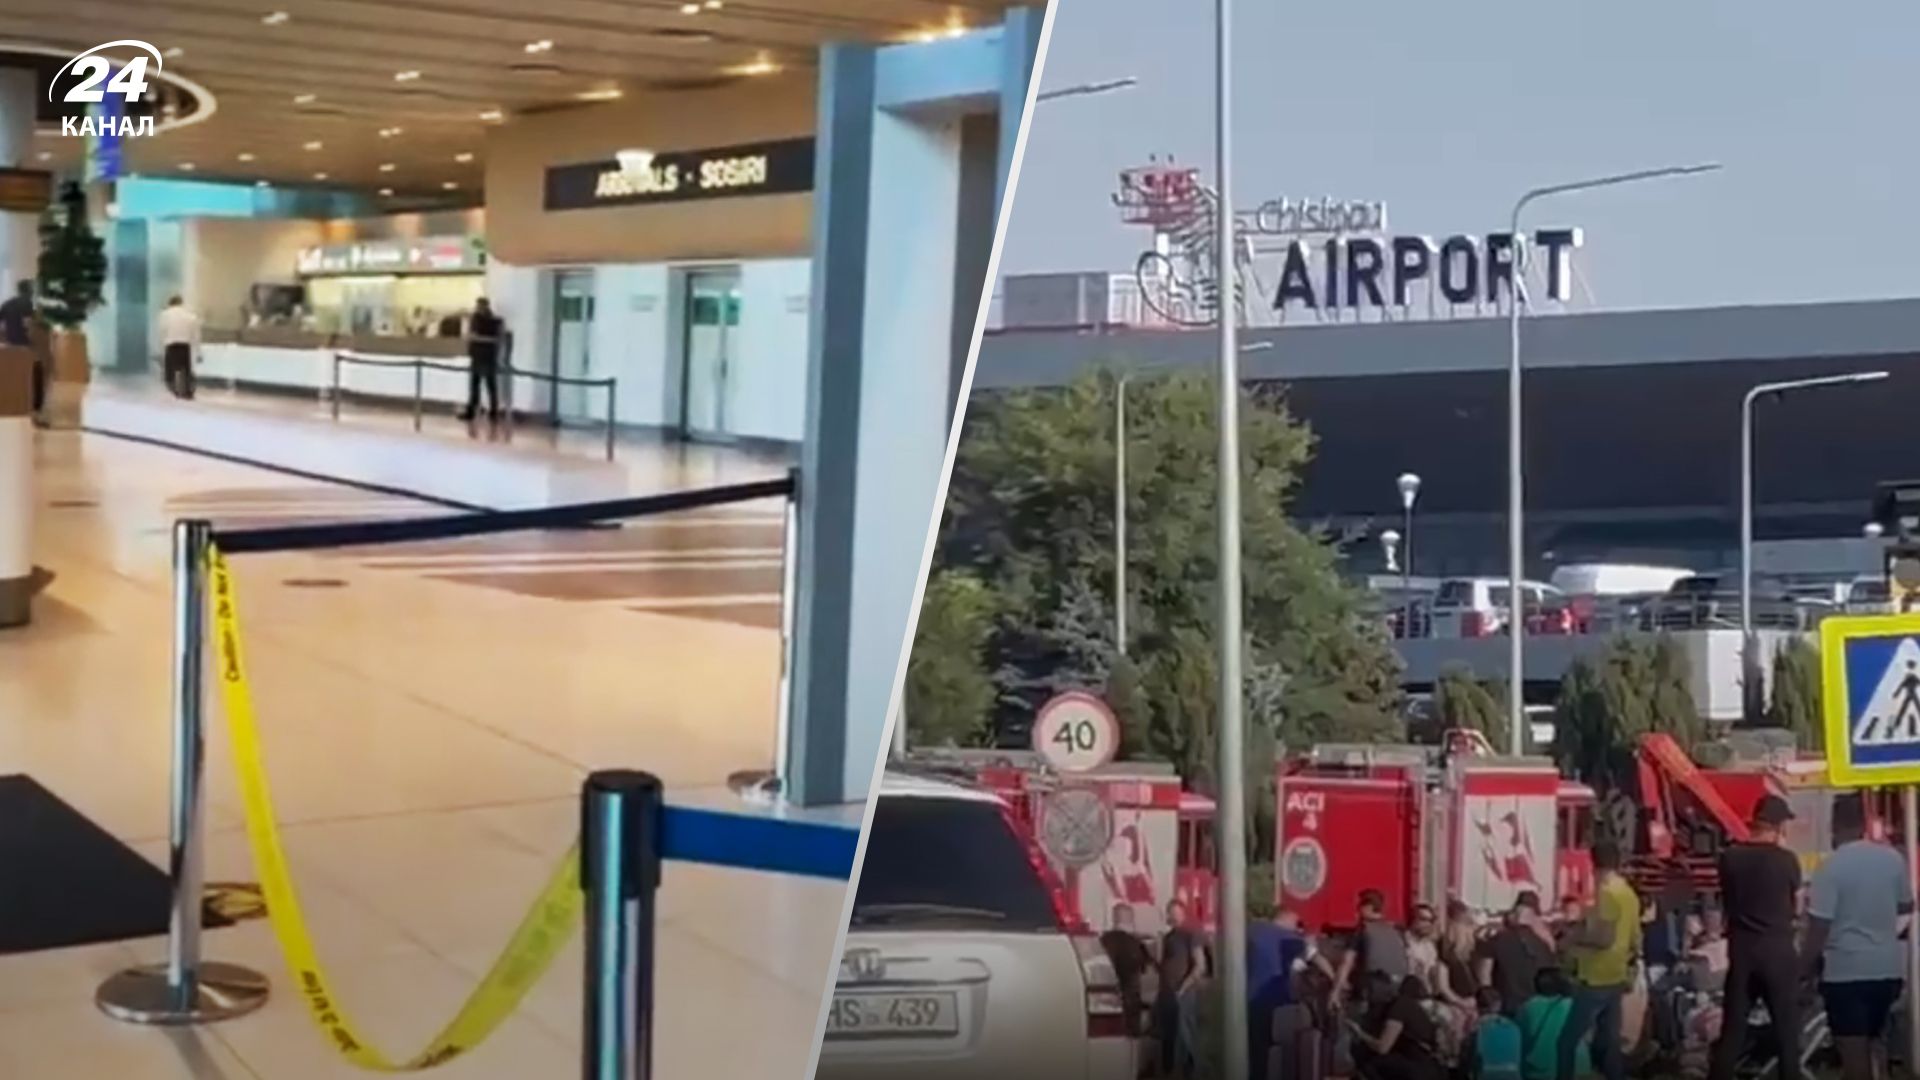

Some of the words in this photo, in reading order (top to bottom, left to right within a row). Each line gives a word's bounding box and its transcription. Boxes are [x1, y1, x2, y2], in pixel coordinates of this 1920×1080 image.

[1274, 229, 1583, 309] AIRPORT
[1053, 719, 1096, 754] 40
[886, 997, 940, 1027] 439
